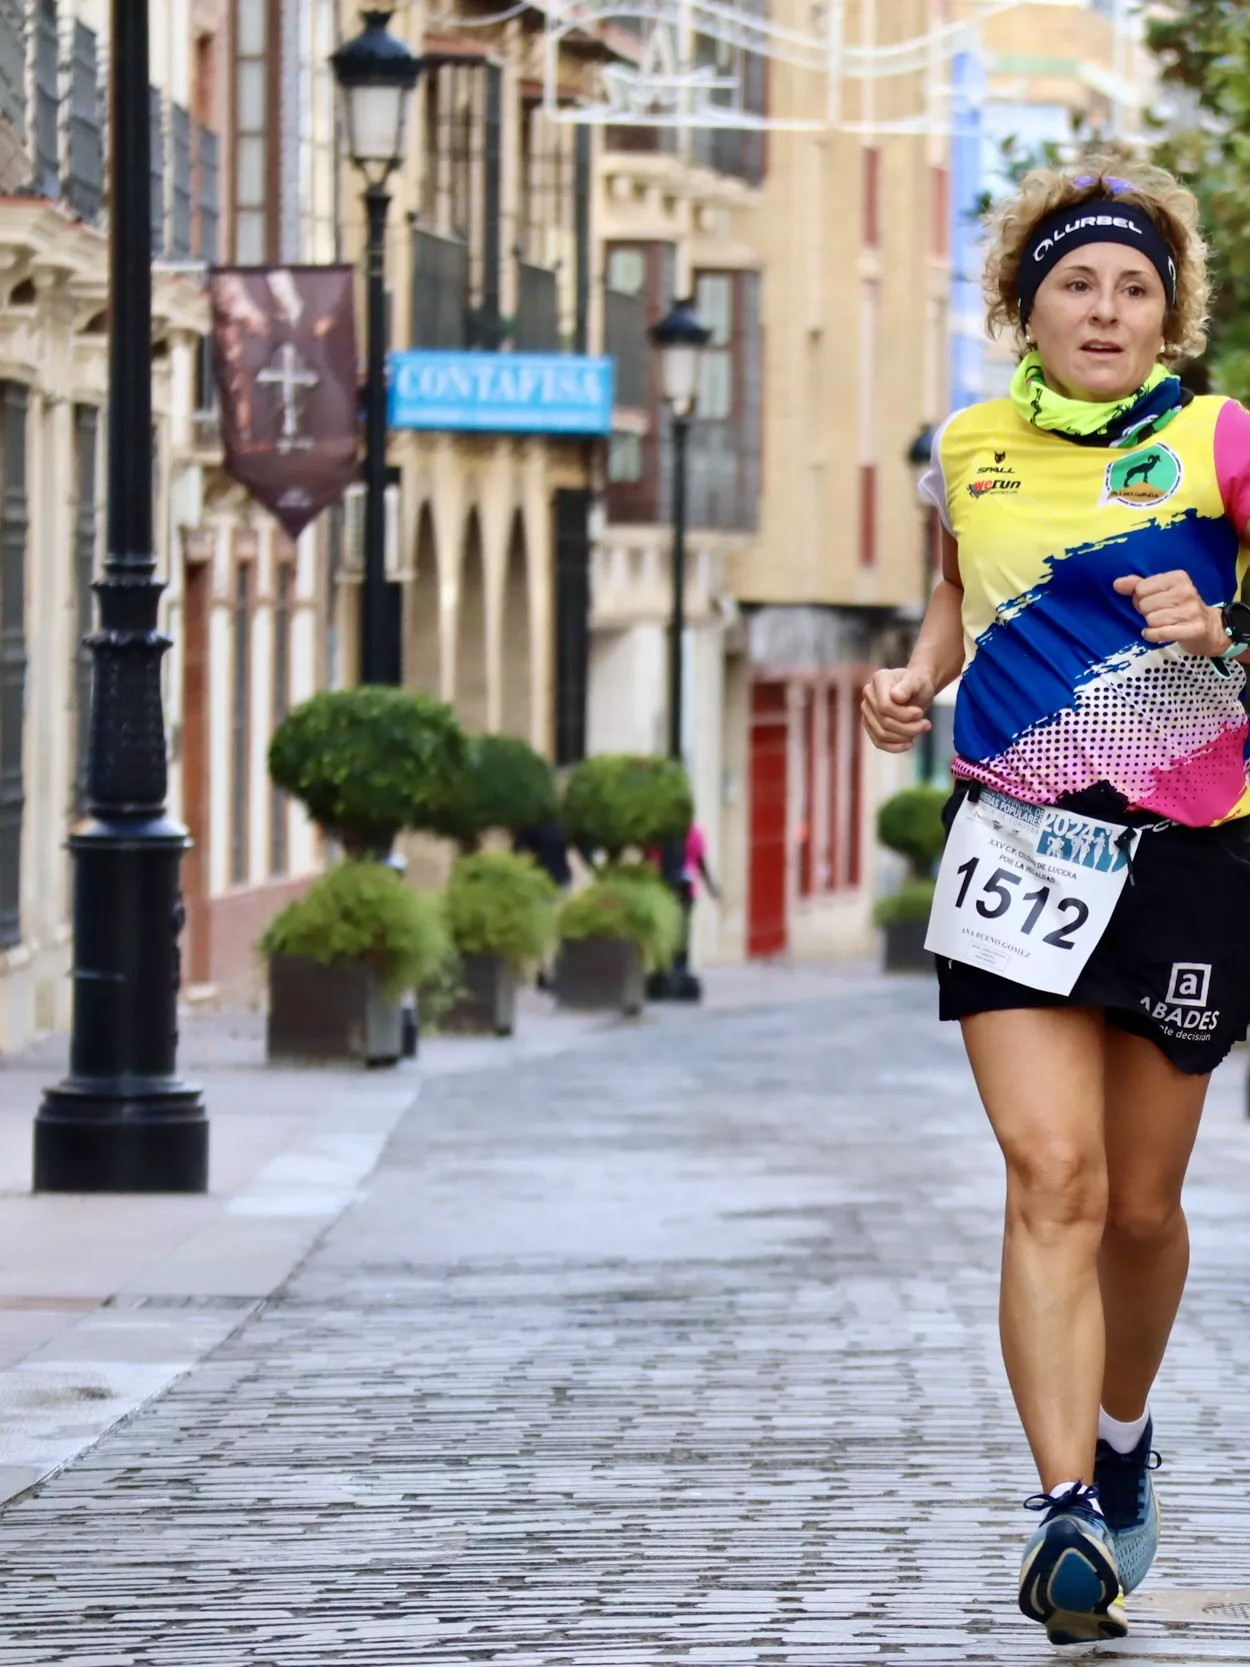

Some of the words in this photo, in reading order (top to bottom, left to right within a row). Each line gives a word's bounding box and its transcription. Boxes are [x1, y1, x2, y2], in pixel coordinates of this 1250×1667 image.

[1053, 214, 1143, 241] LURBEL
[396, 363, 603, 405] CONTAFISA
[1000, 800, 1042, 827] POPULARES
[1041, 813, 1096, 842] 2024
[999, 854, 1014, 866] POR
[1014, 860, 1025, 870] LA
[1037, 861, 1047, 871] DE
[1048, 865, 1077, 880] LUCENA
[954, 856, 1090, 950] 1512
[961, 927, 974, 937] ANA
[975, 931, 1001, 946] BUENO
[1001, 941, 1031, 958] GOMEZ
[1178, 972, 1198, 995] a
